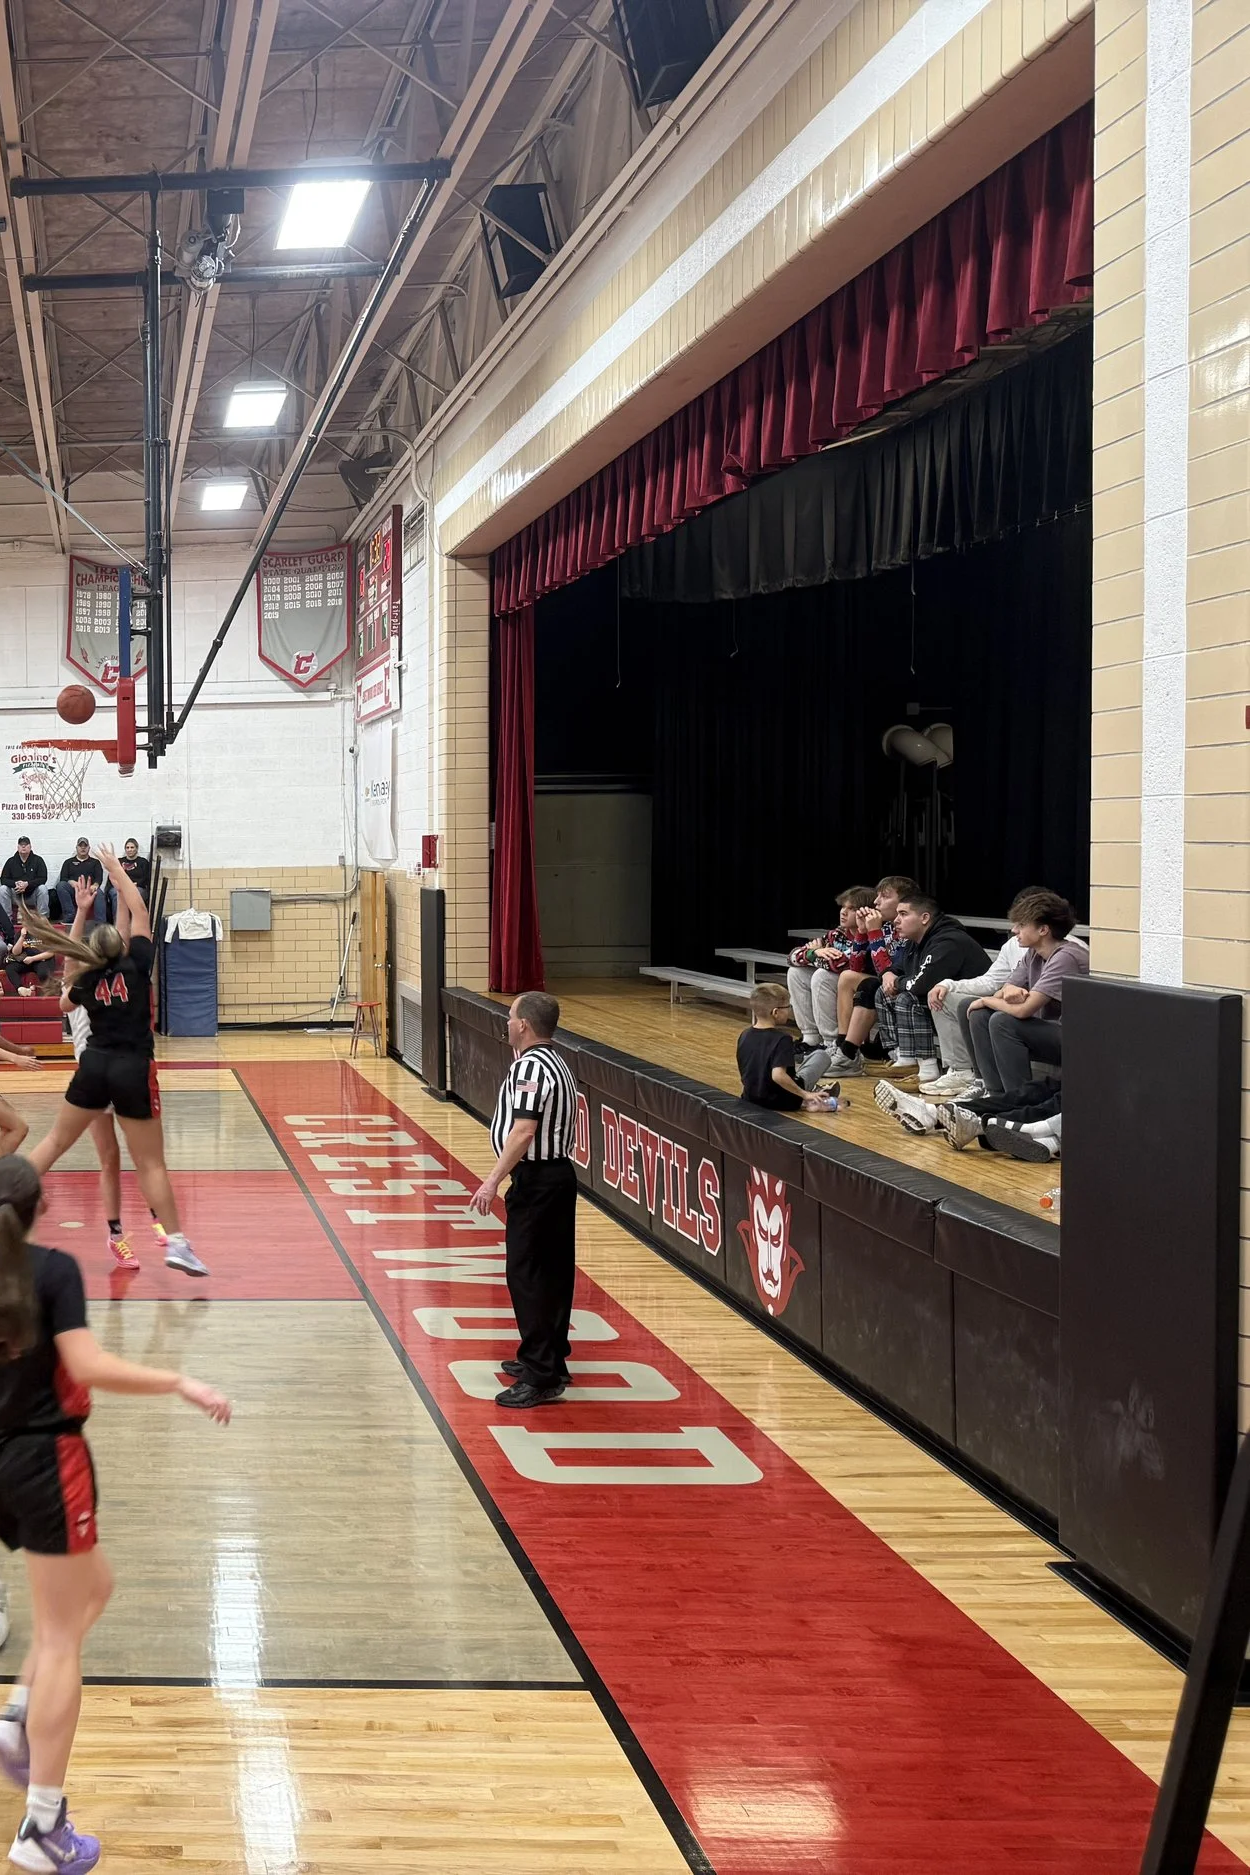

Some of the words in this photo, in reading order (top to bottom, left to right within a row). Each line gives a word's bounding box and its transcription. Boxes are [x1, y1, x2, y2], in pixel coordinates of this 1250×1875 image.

[262, 556, 303, 569] SCARLET
[308, 551, 345, 565] GUARD
[294, 652, 315, 675] C
[10, 753, 57, 764] Gionino's
[1, 803, 19, 811] Pizza
[94, 972, 129, 1006] 44
[601, 1103, 721, 1257] DEVILS
[282, 1114, 764, 1486] CRESTWOOD
